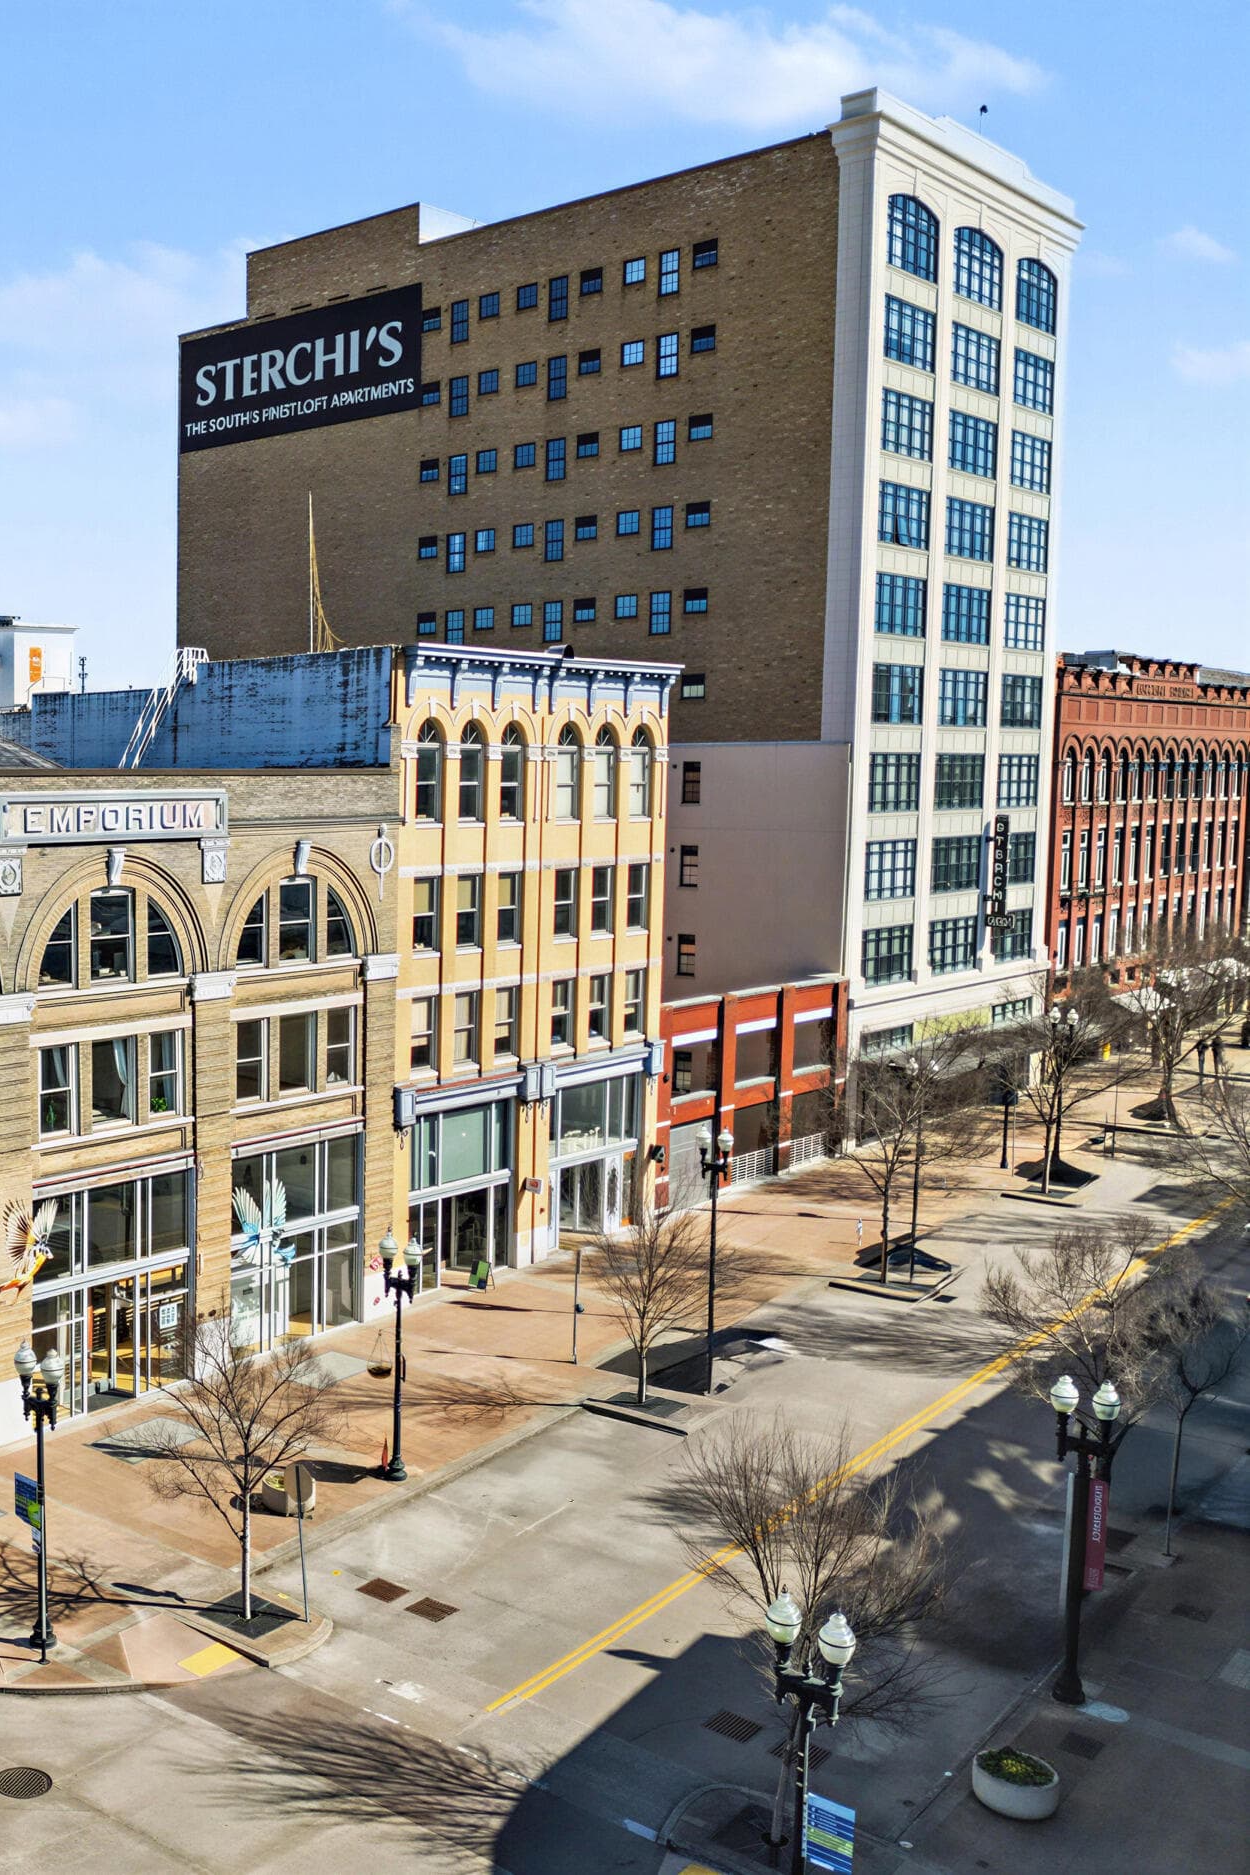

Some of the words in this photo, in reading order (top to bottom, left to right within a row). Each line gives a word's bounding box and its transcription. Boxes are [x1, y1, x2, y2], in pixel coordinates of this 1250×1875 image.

[195, 320, 404, 407] STERCHI'S
[185, 420, 208, 438] THE
[208, 409, 260, 433] SOUTH'S
[262, 400, 297, 423] FINEST
[297, 395, 328, 415] LOFT
[330, 377, 415, 409] APARTMENTS
[23, 803, 205, 834] EMPORIUM
